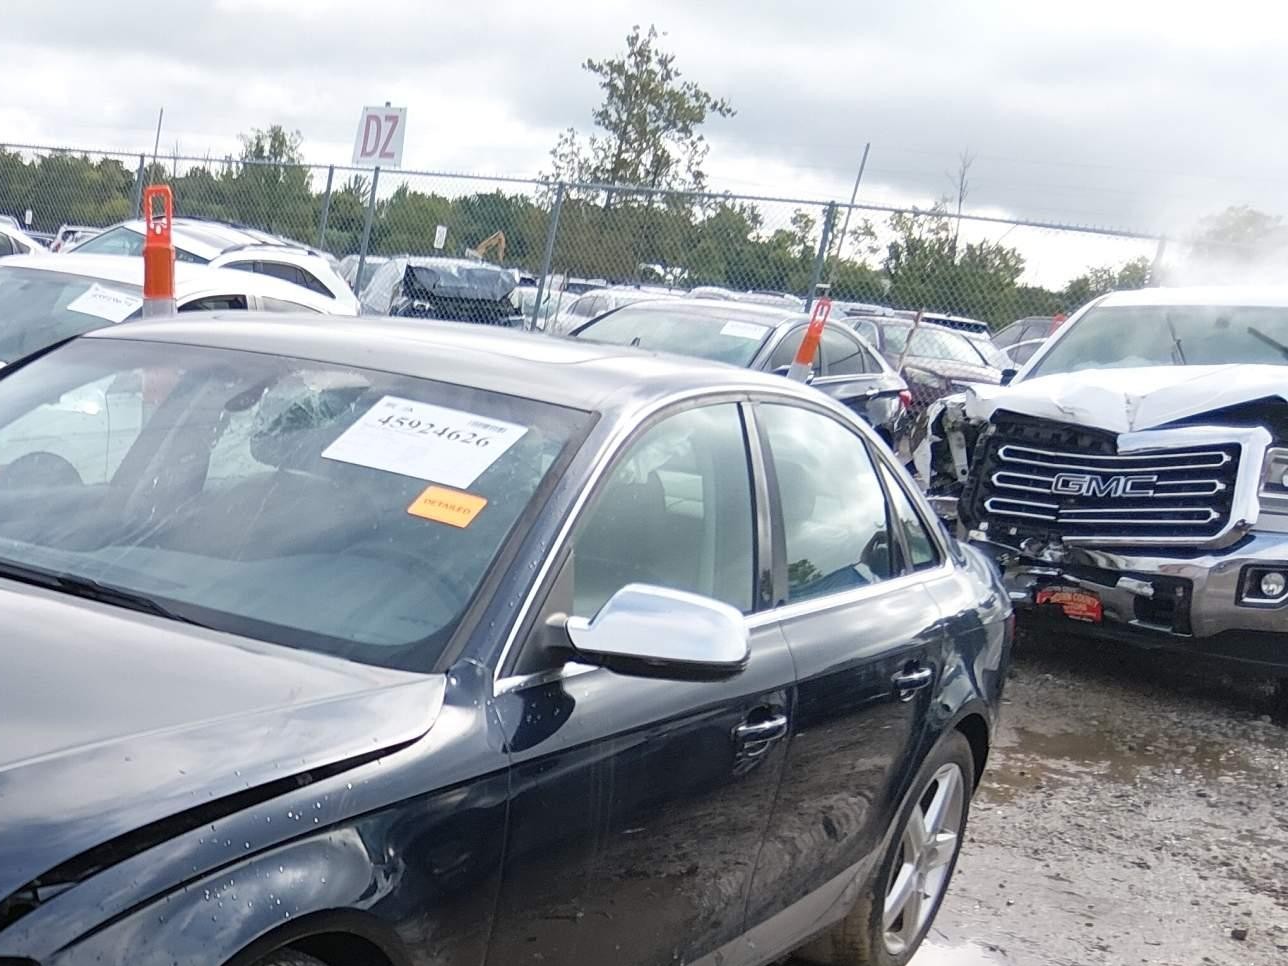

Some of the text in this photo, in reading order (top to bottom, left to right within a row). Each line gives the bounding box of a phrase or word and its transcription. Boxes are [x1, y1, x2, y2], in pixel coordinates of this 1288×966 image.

[360, 114, 399, 159] DZ
[377, 413, 490, 448] 45924626
[1052, 472, 1158, 497] GMC
[423, 498, 472, 515] DETAILED
